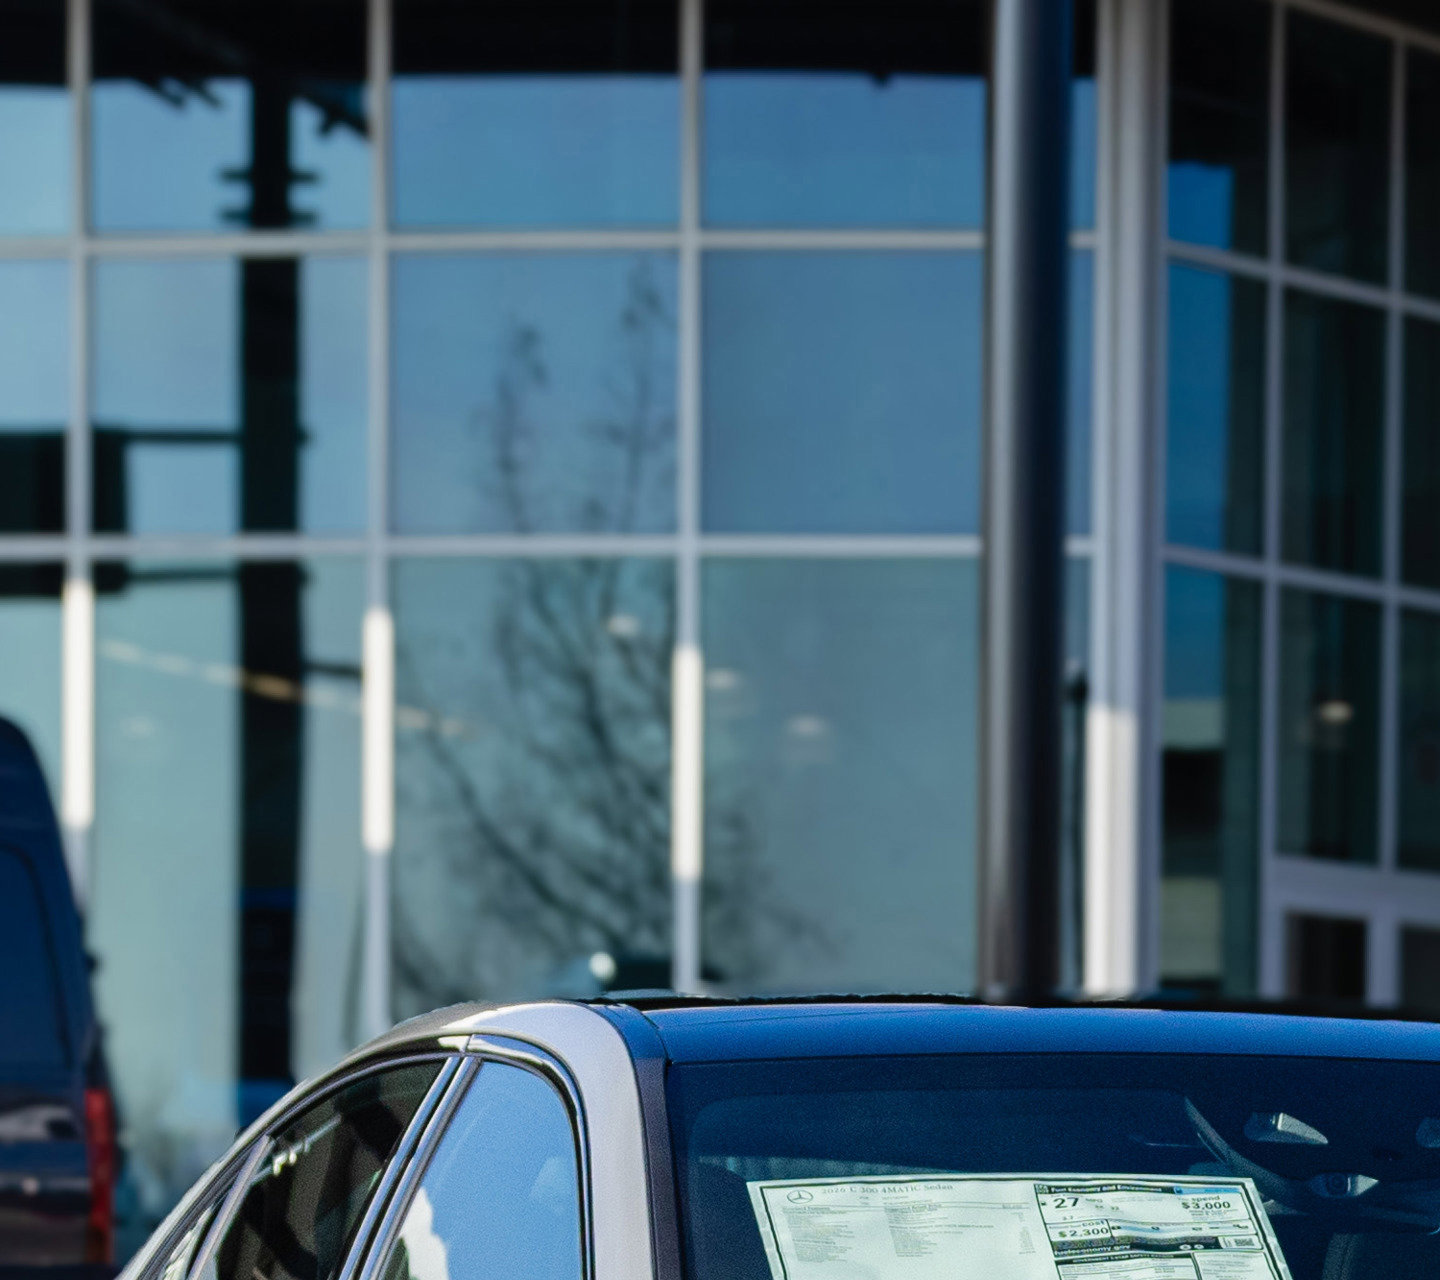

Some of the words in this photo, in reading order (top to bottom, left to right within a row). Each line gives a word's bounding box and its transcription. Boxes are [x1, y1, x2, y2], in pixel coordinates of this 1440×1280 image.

[1054, 1197, 1079, 1209] 27
[1182, 1201, 1231, 1210] $3,000
[1058, 1228, 1109, 1238] $2,300
